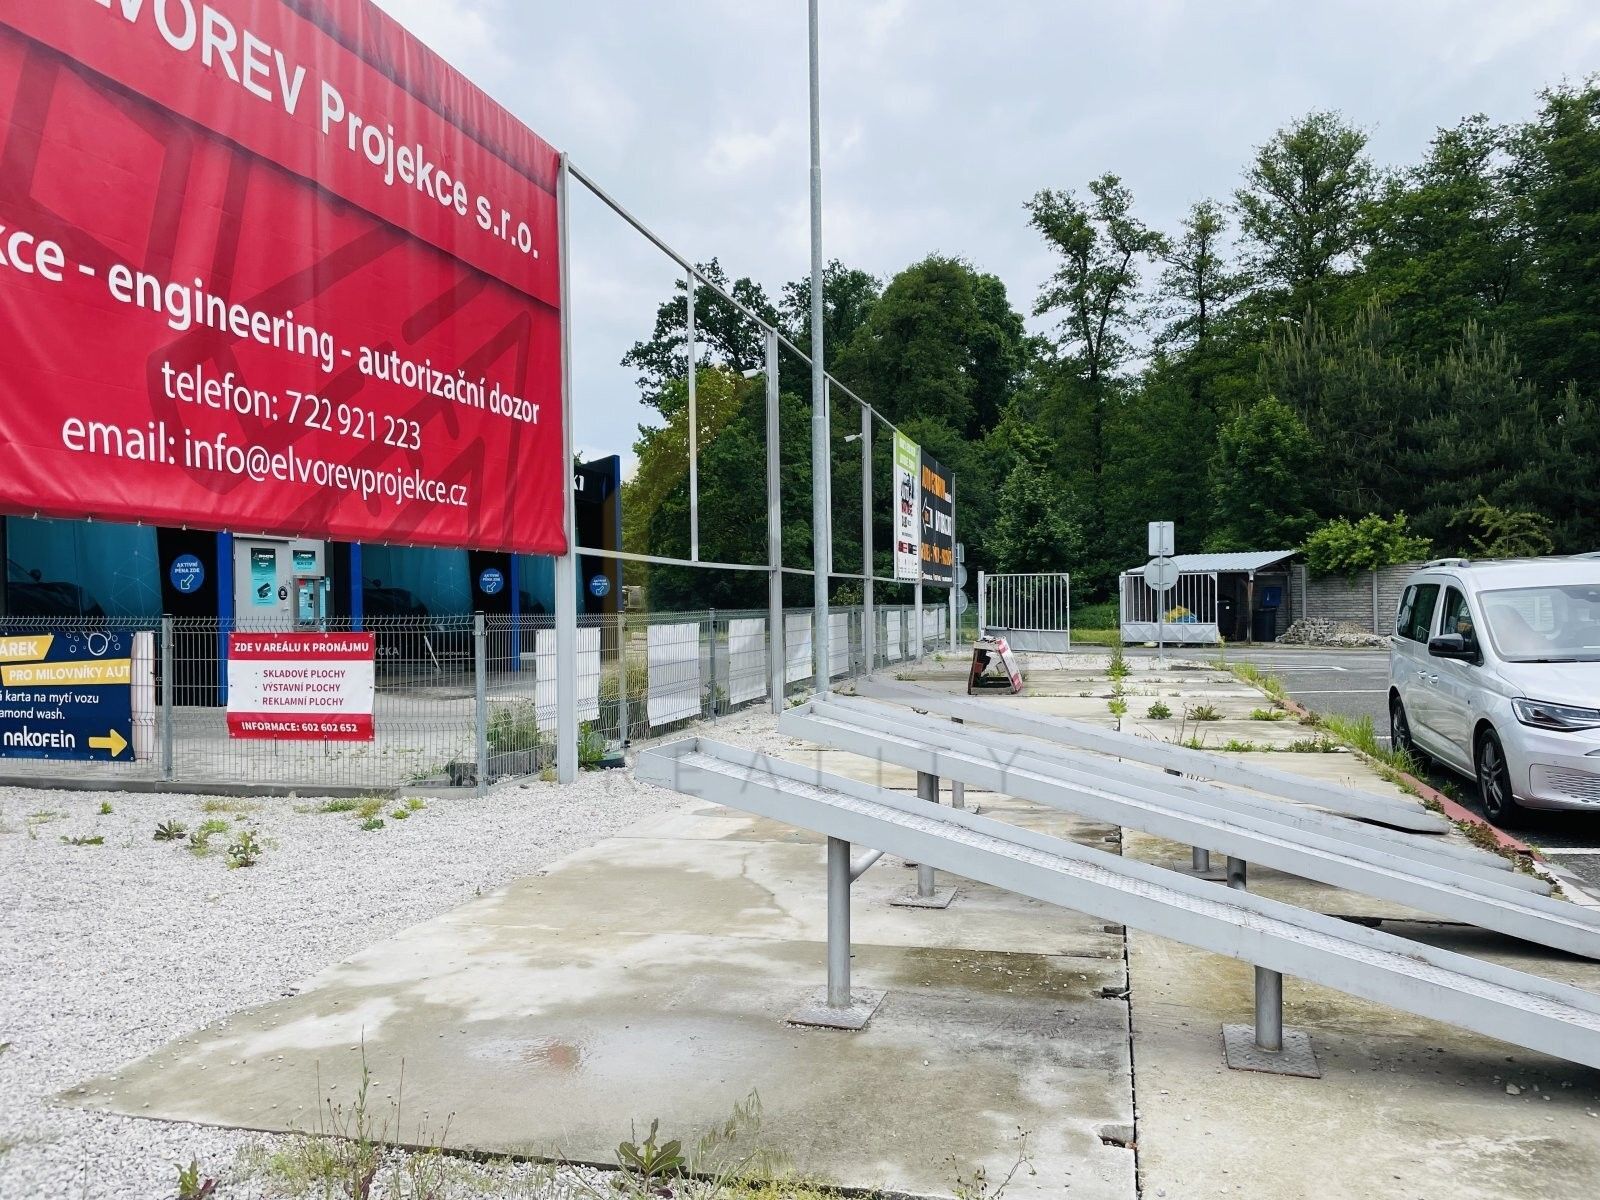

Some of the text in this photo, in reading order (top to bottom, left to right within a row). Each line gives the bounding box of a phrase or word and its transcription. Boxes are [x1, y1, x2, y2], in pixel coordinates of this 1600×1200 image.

[95, 0, 539, 259] OREV Projekce s.r.o.
[108, 264, 334, 373] engineering
[359, 346, 486, 410] autorizační
[490, 382, 540, 425] dozor
[161, 361, 421, 450] telefon: 722 921 223
[62, 417, 468, 505] email: info@elvorevprojekce.cz
[235, 640, 369, 652] ZDE V AREÁLU K PRONÁJMU
[9, 669, 33, 681] PRO
[36, 664, 103, 680] MILOVNÍKY
[263, 669, 346, 678] SKLADOVÉ PLOCHY
[262, 682, 341, 692] VÝSTAVNÍ PLOCHY
[5, 689, 31, 702] karta
[34, 693, 46, 703] na
[49, 692, 73, 706] mytí
[75, 694, 99, 704] vozu
[262, 696, 345, 706] REKLAMNÍ PLOCHY
[36, 707, 66, 720] wash.
[241, 722, 358, 733] INFORMACE: 602 602 652
